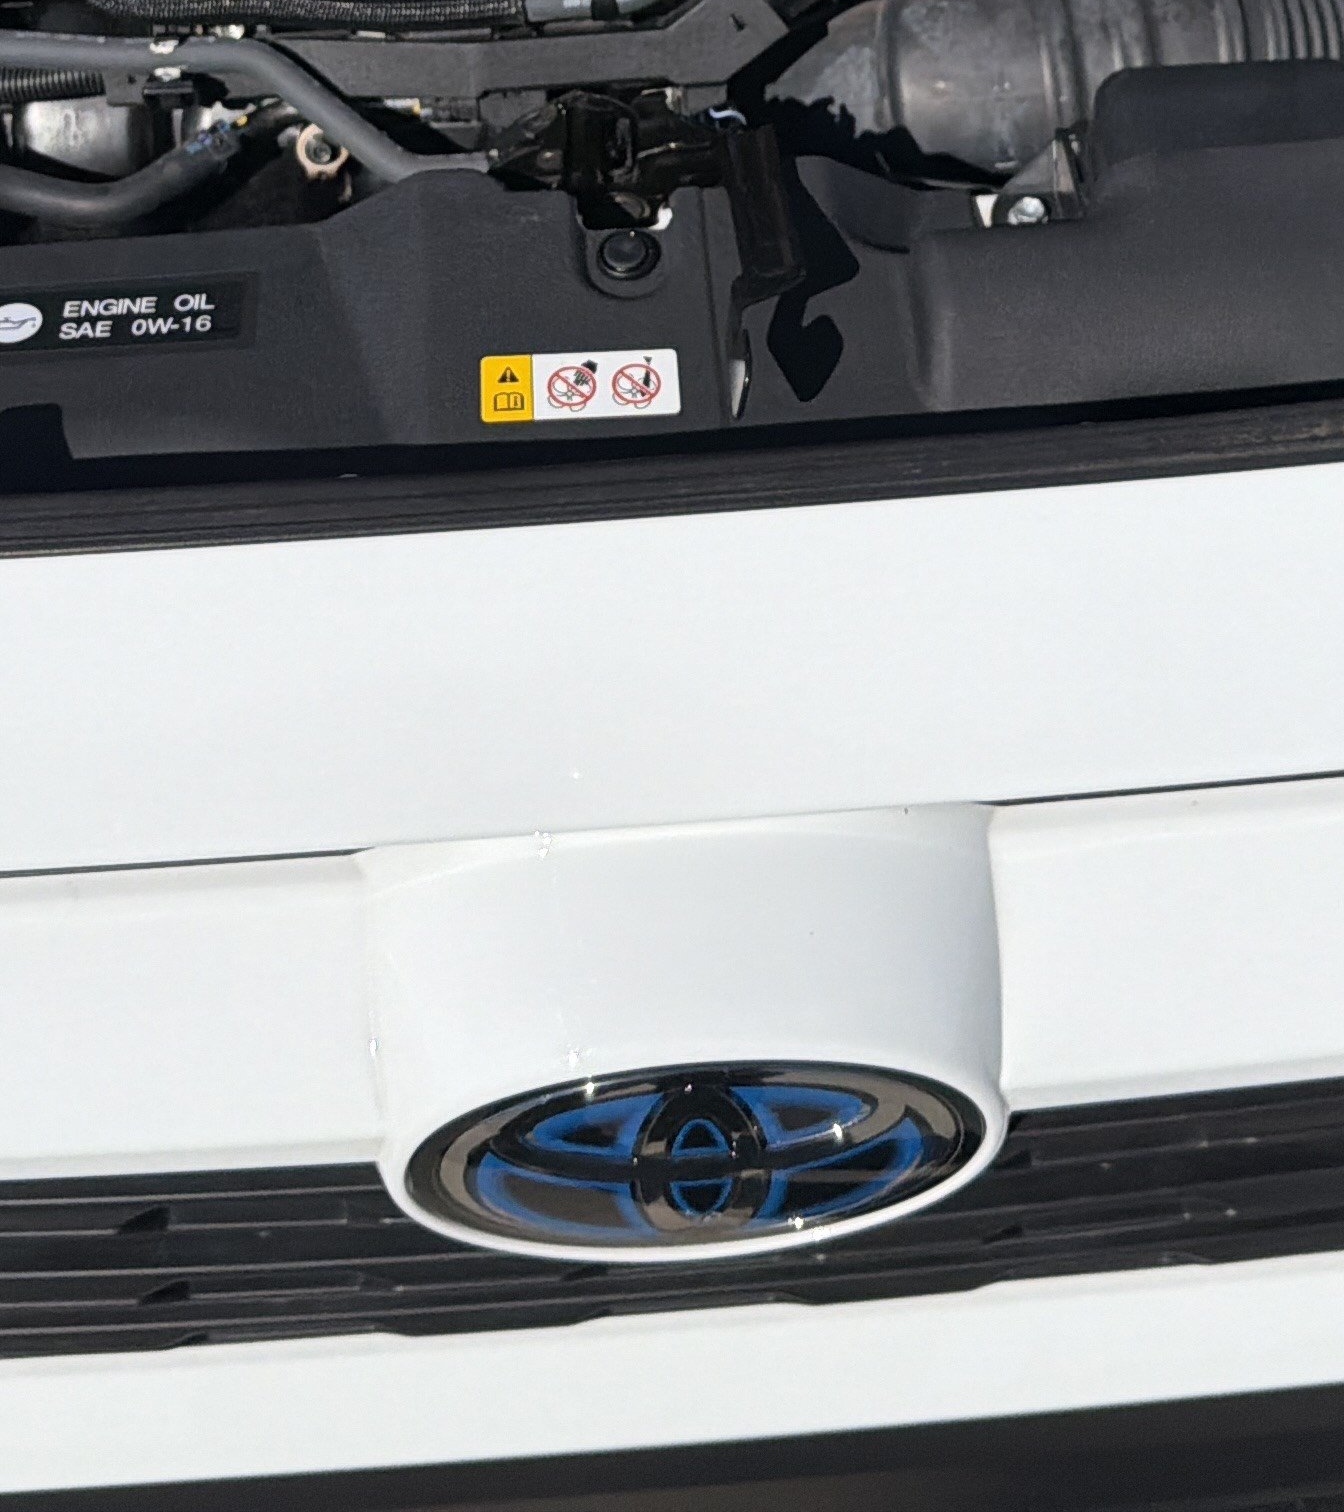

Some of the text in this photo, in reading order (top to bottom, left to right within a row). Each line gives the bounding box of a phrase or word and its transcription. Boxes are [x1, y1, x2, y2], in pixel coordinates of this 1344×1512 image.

[62, 293, 215, 319] ENGINE OIL
[59, 314, 212, 339] SAE 0W-16
